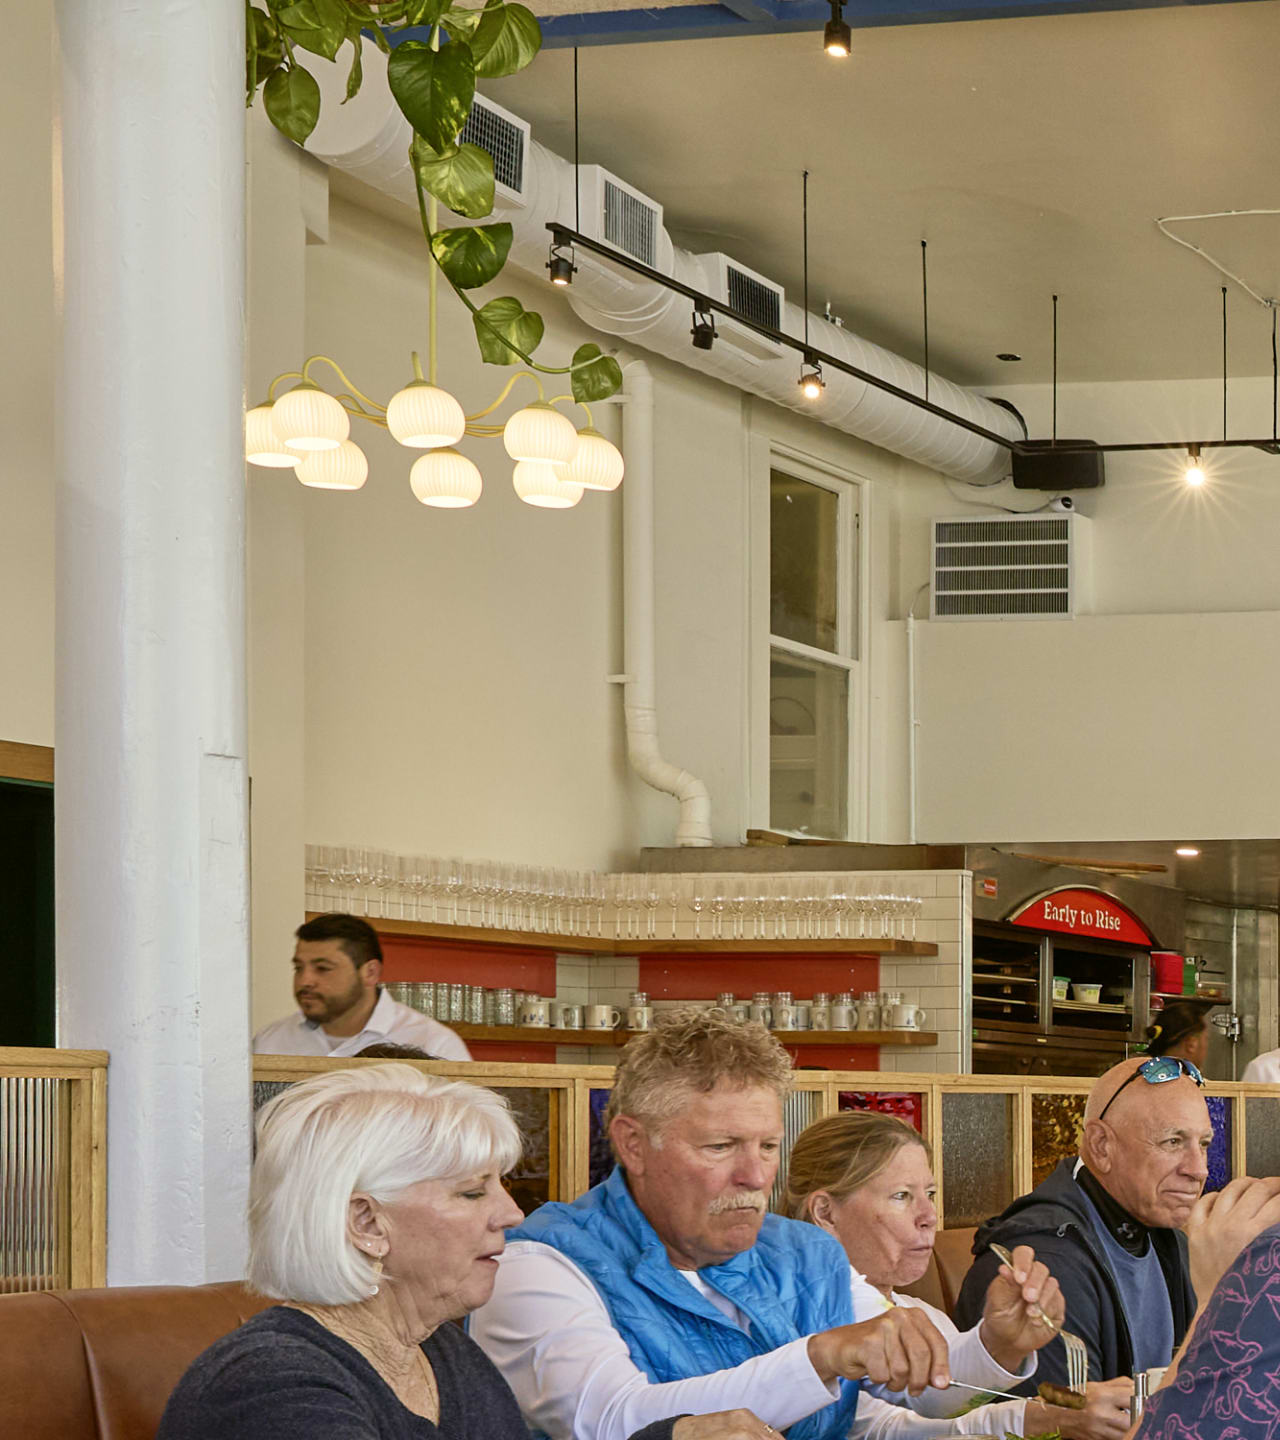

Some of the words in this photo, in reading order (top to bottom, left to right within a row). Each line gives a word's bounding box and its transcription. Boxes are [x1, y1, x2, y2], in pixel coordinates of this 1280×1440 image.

[1043, 900, 1078, 928] Early
[1080, 909, 1093, 926] to
[1095, 908, 1121, 931] Rise
